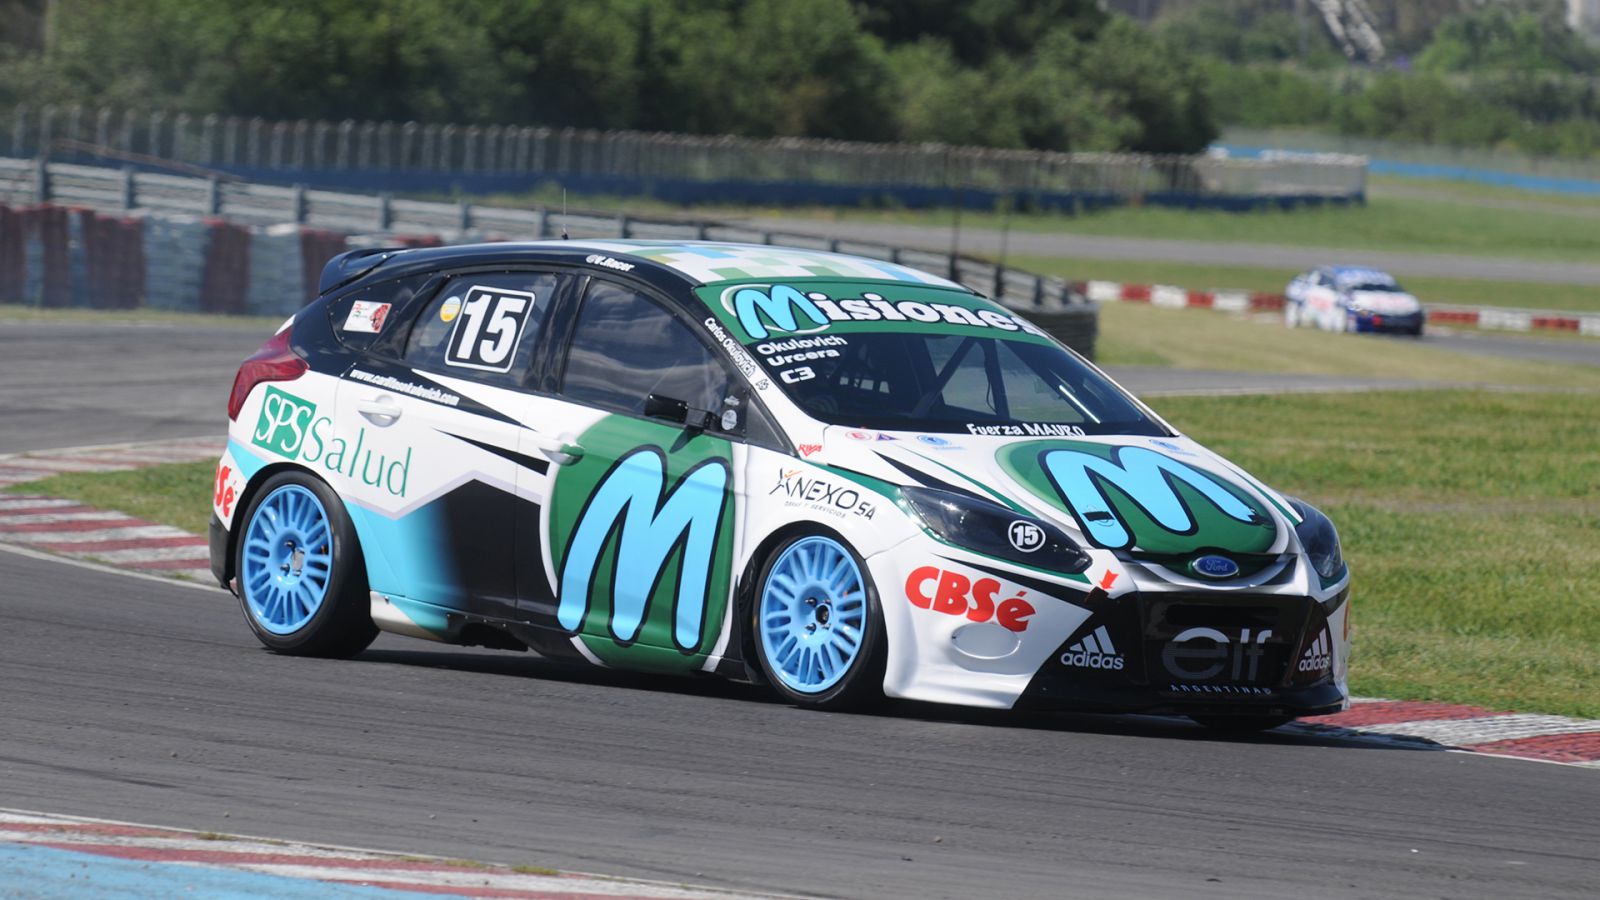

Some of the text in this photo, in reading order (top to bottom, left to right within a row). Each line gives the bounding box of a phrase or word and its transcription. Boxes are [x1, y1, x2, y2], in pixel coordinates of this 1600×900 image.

[456, 294, 527, 363] 15
[733, 284, 1049, 338] Misiones
[704, 317, 726, 343] Carlos
[723, 337, 756, 377] Okulovich
[757, 335, 848, 355] Okulovich
[767, 349, 840, 366] Urcera
[780, 366, 816, 384] C3
[255, 393, 412, 498] SPS Salud
[966, 422, 1086, 437] Fuerza MAURO
[853, 501, 876, 520] SA
[1037, 445, 1256, 551] M
[556, 444, 731, 655] M
[1013, 525, 1039, 547] 15
[1205, 559, 1228, 571] Ford
[905, 566, 1036, 632] CBSé
[1061, 651, 1124, 670] adidas
[1162, 627, 1273, 681] elf
